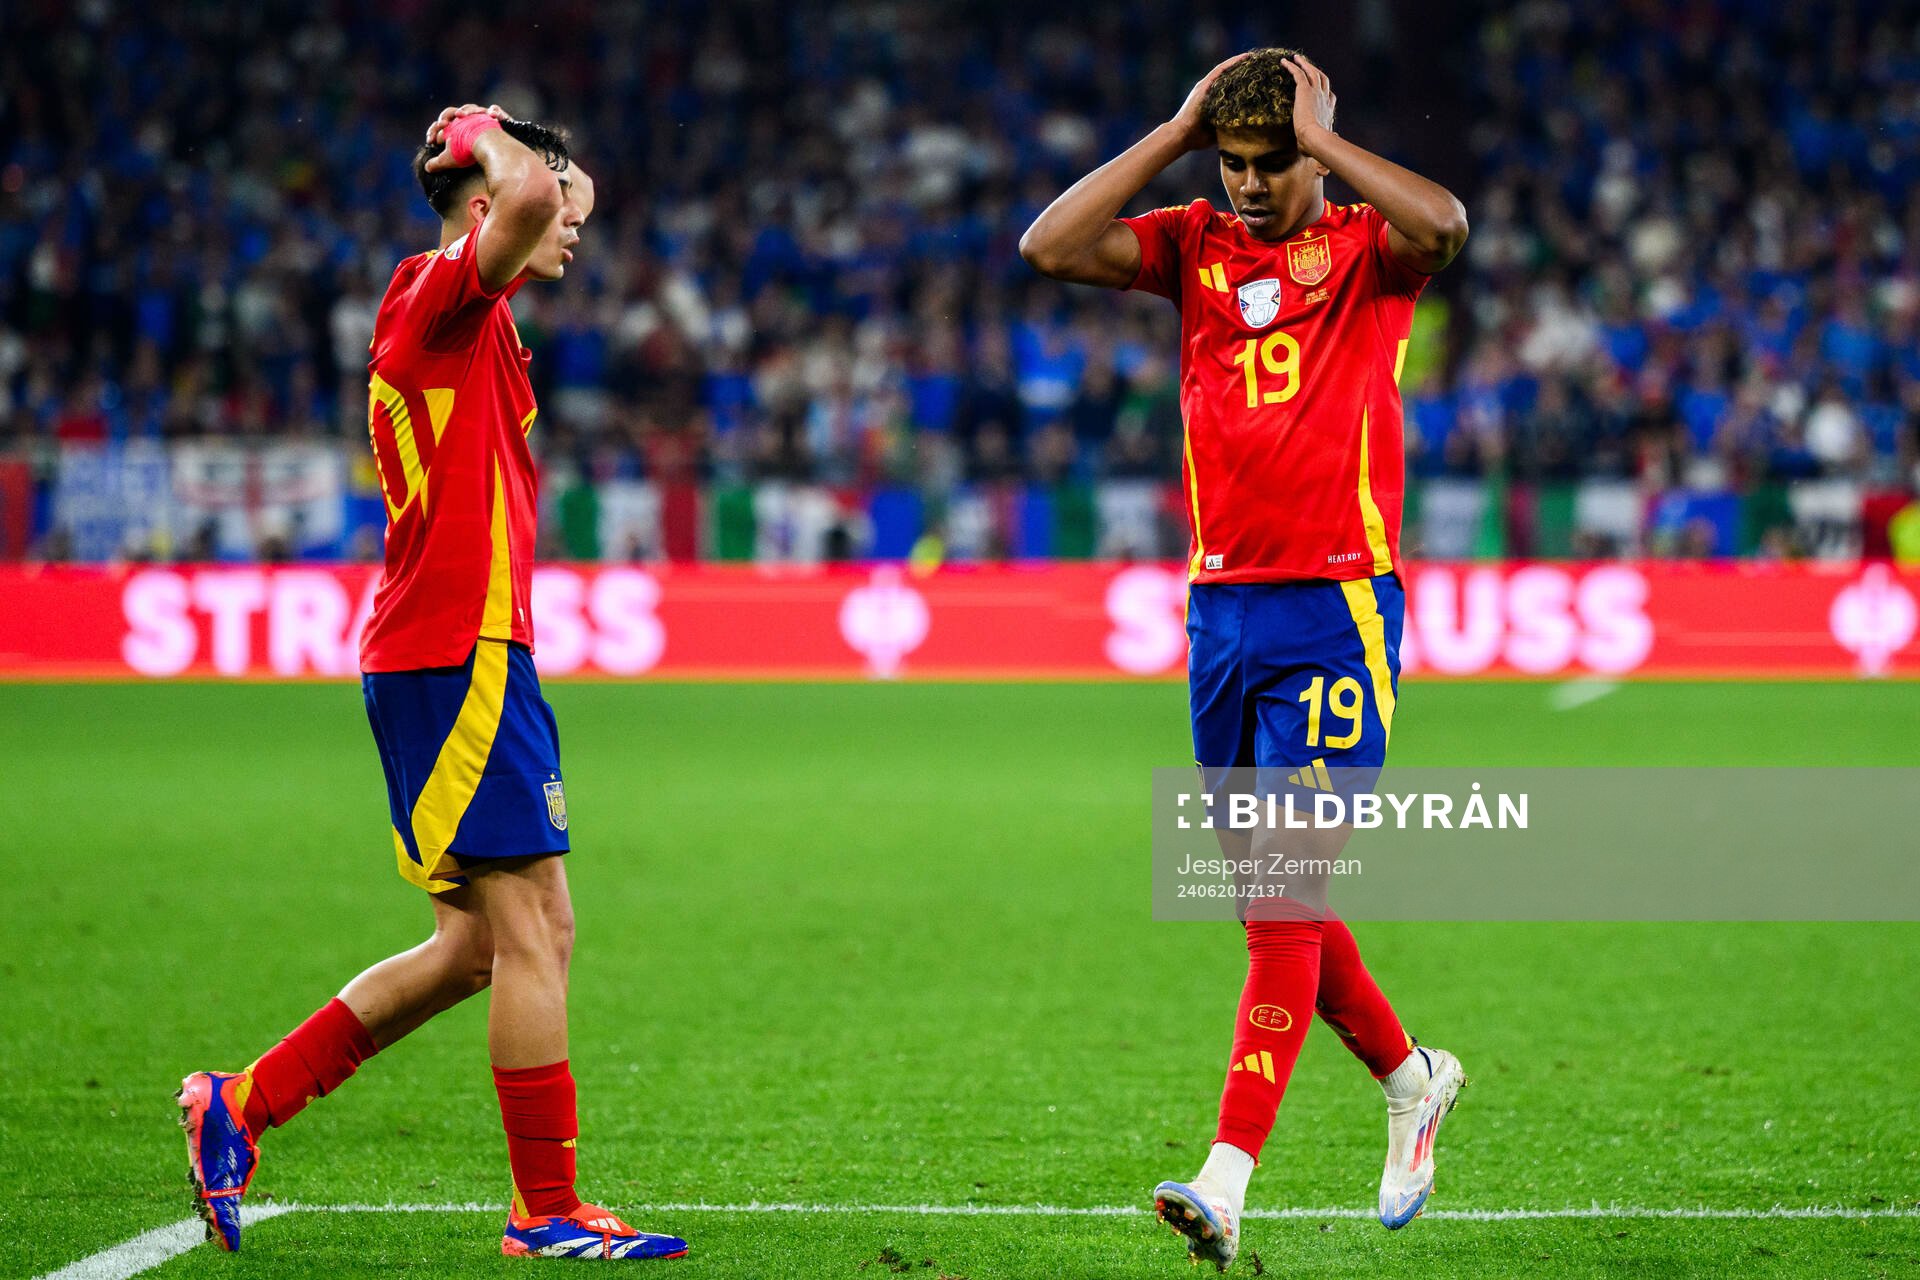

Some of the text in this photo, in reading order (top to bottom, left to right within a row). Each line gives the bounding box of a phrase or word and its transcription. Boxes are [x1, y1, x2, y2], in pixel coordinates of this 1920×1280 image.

[1234, 332, 1300, 408] 19
[121, 568, 666, 677] STRSS
[1105, 566, 1655, 675] SUSS
[1299, 676, 1364, 749] 19
